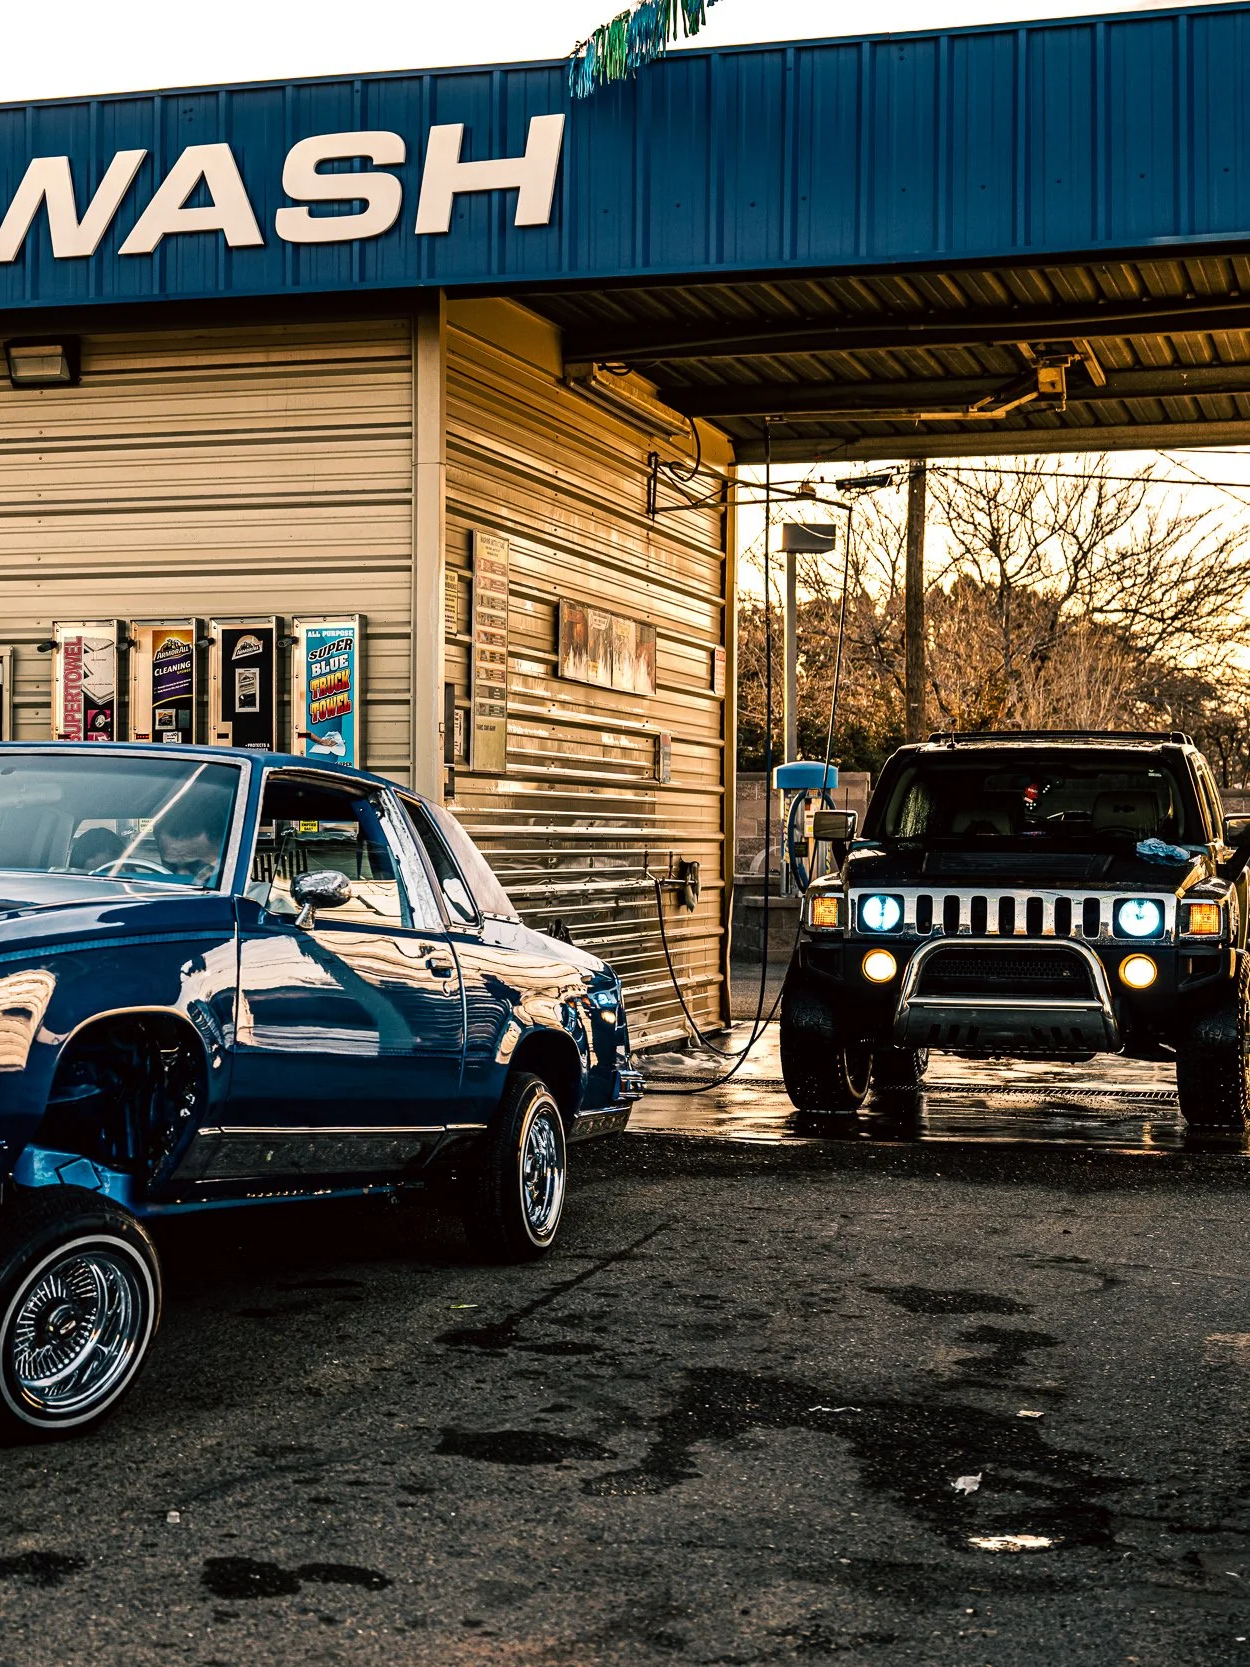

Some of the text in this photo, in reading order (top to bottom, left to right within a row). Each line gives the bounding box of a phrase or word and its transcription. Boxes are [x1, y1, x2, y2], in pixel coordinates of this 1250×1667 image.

[308, 637, 354, 662] SUPER
[154, 661, 191, 676] CLEANING
[311, 653, 350, 678] BLUE
[310, 668, 351, 700] TRUCK
[310, 692, 352, 724] TOWEL
